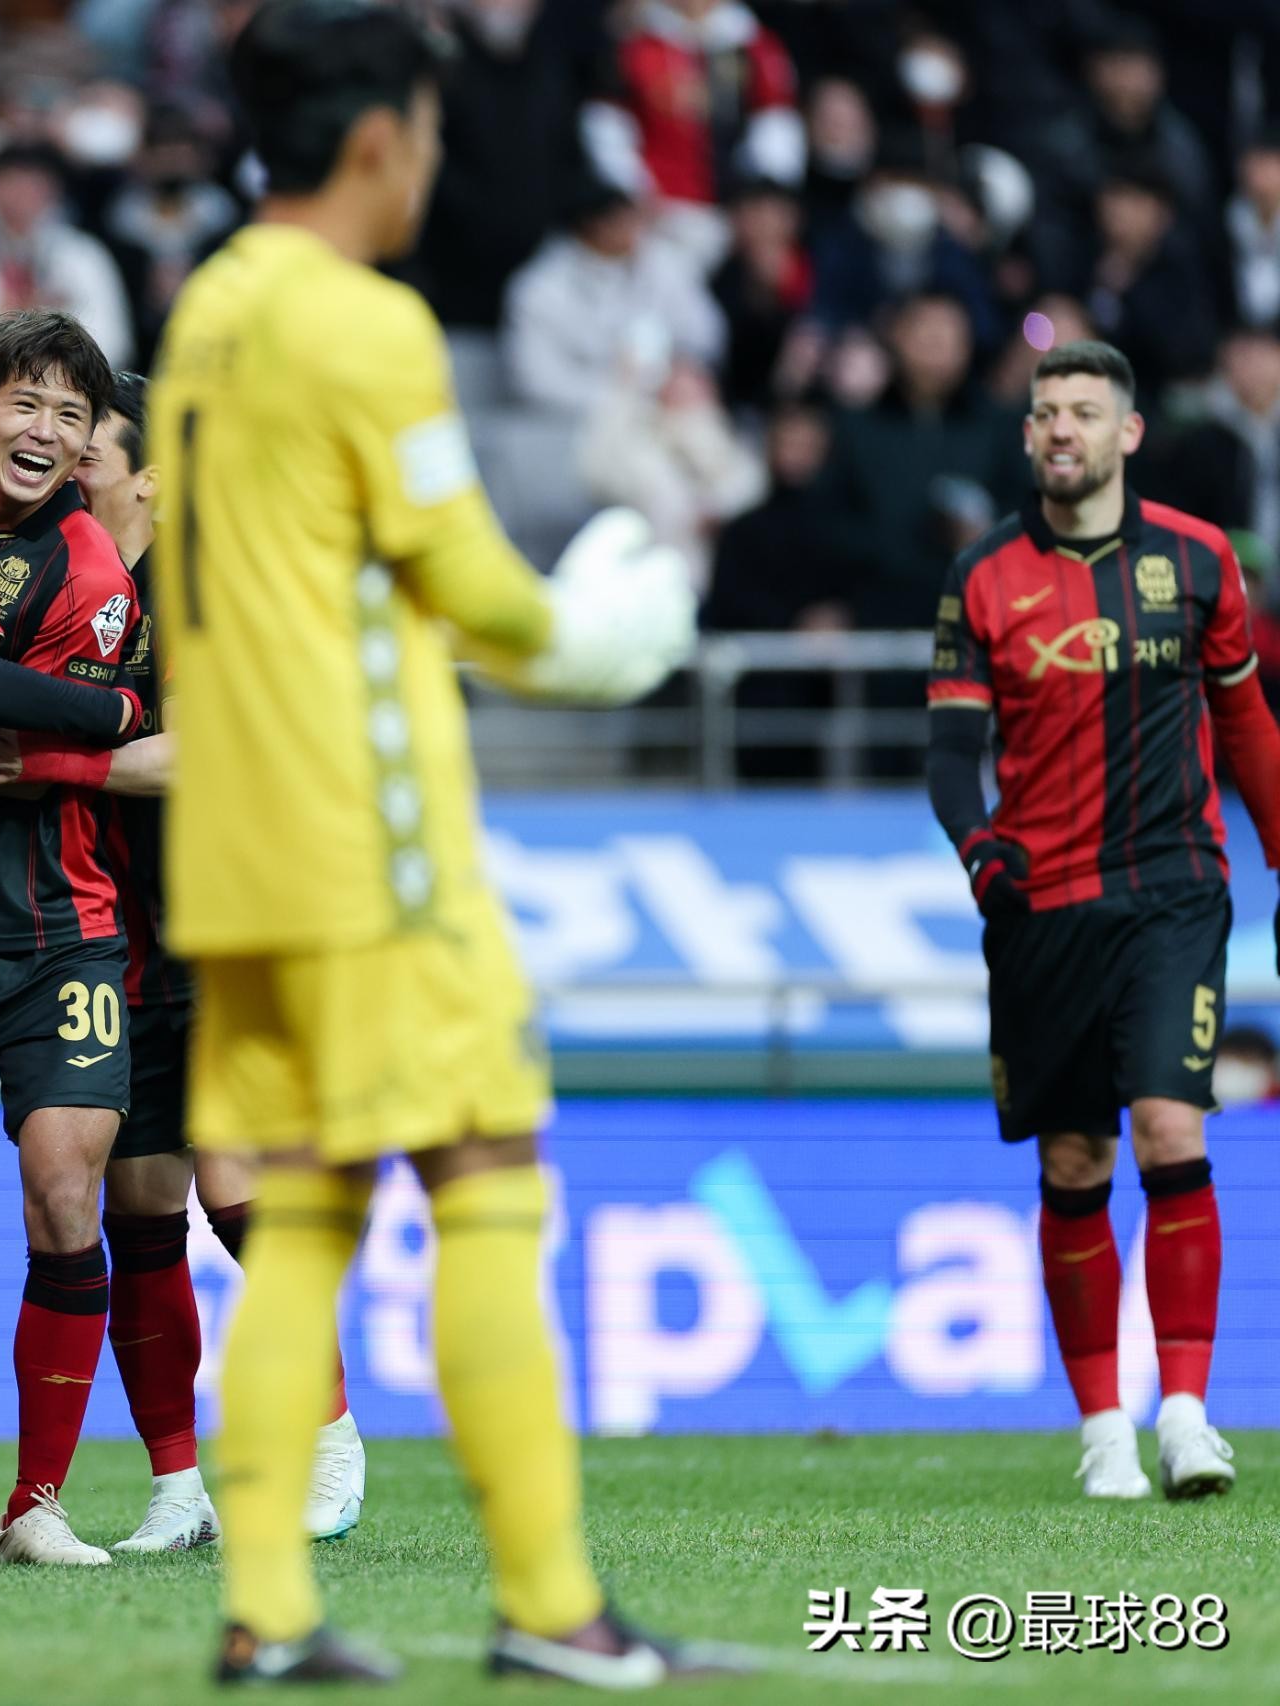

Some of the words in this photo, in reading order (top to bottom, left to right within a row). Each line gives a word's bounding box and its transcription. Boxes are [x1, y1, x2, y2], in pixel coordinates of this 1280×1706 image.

[69, 661, 88, 675] GS
[58, 981, 120, 1047] 30
[1192, 983, 1216, 1051] 5
